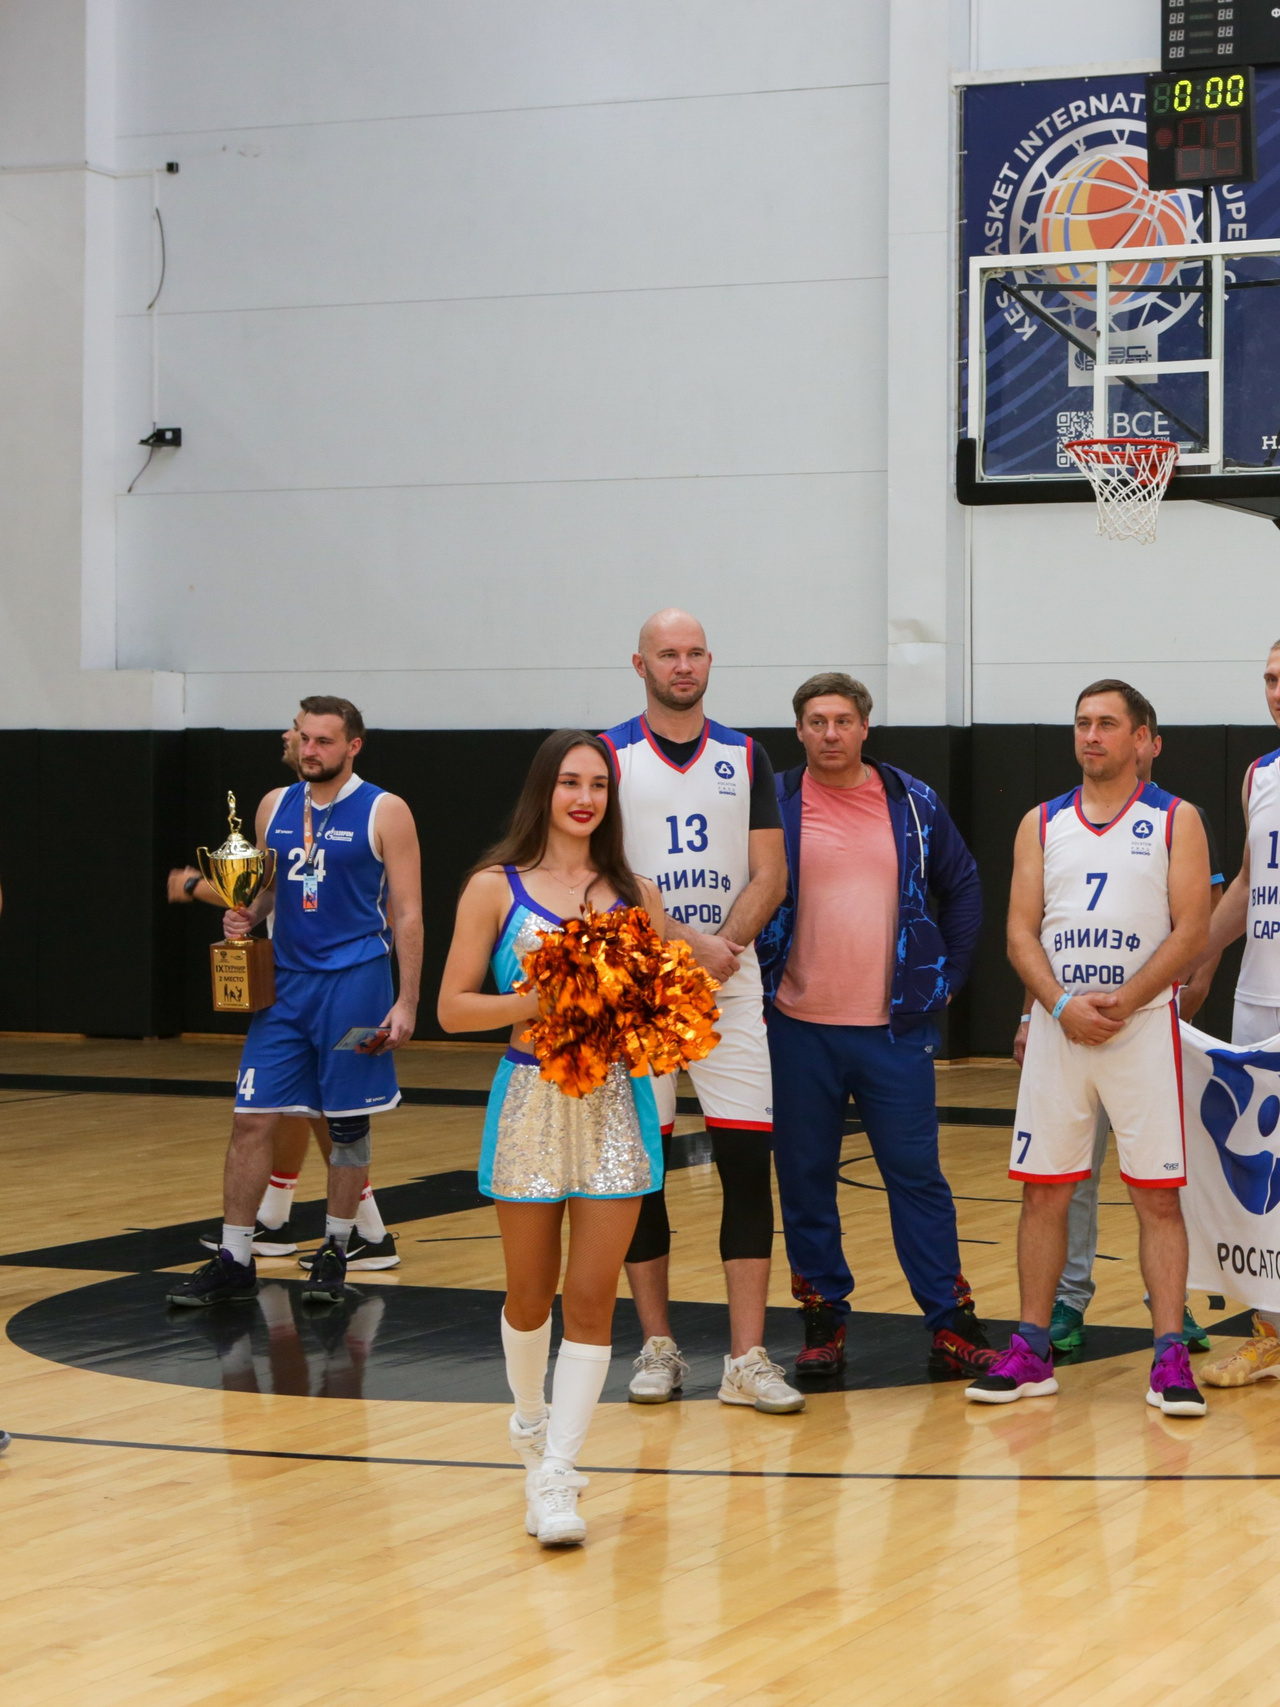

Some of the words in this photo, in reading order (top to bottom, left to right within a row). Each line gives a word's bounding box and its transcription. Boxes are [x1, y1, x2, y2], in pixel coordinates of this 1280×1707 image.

[984, 162, 1020, 255] ASKET
[1113, 411, 1170, 437] ВСЕ
[665, 813, 709, 854] 13
[287, 847, 326, 882] 24
[655, 869, 731, 893] НИИЭФ
[1086, 872, 1108, 911] 7
[664, 904, 722, 924] АРОВ
[1054, 928, 1140, 952] ВНИИЭФ
[1062, 964, 1125, 985] САРОВ
[236, 1068, 255, 1101] 4
[1016, 1131, 1032, 1165] 7
